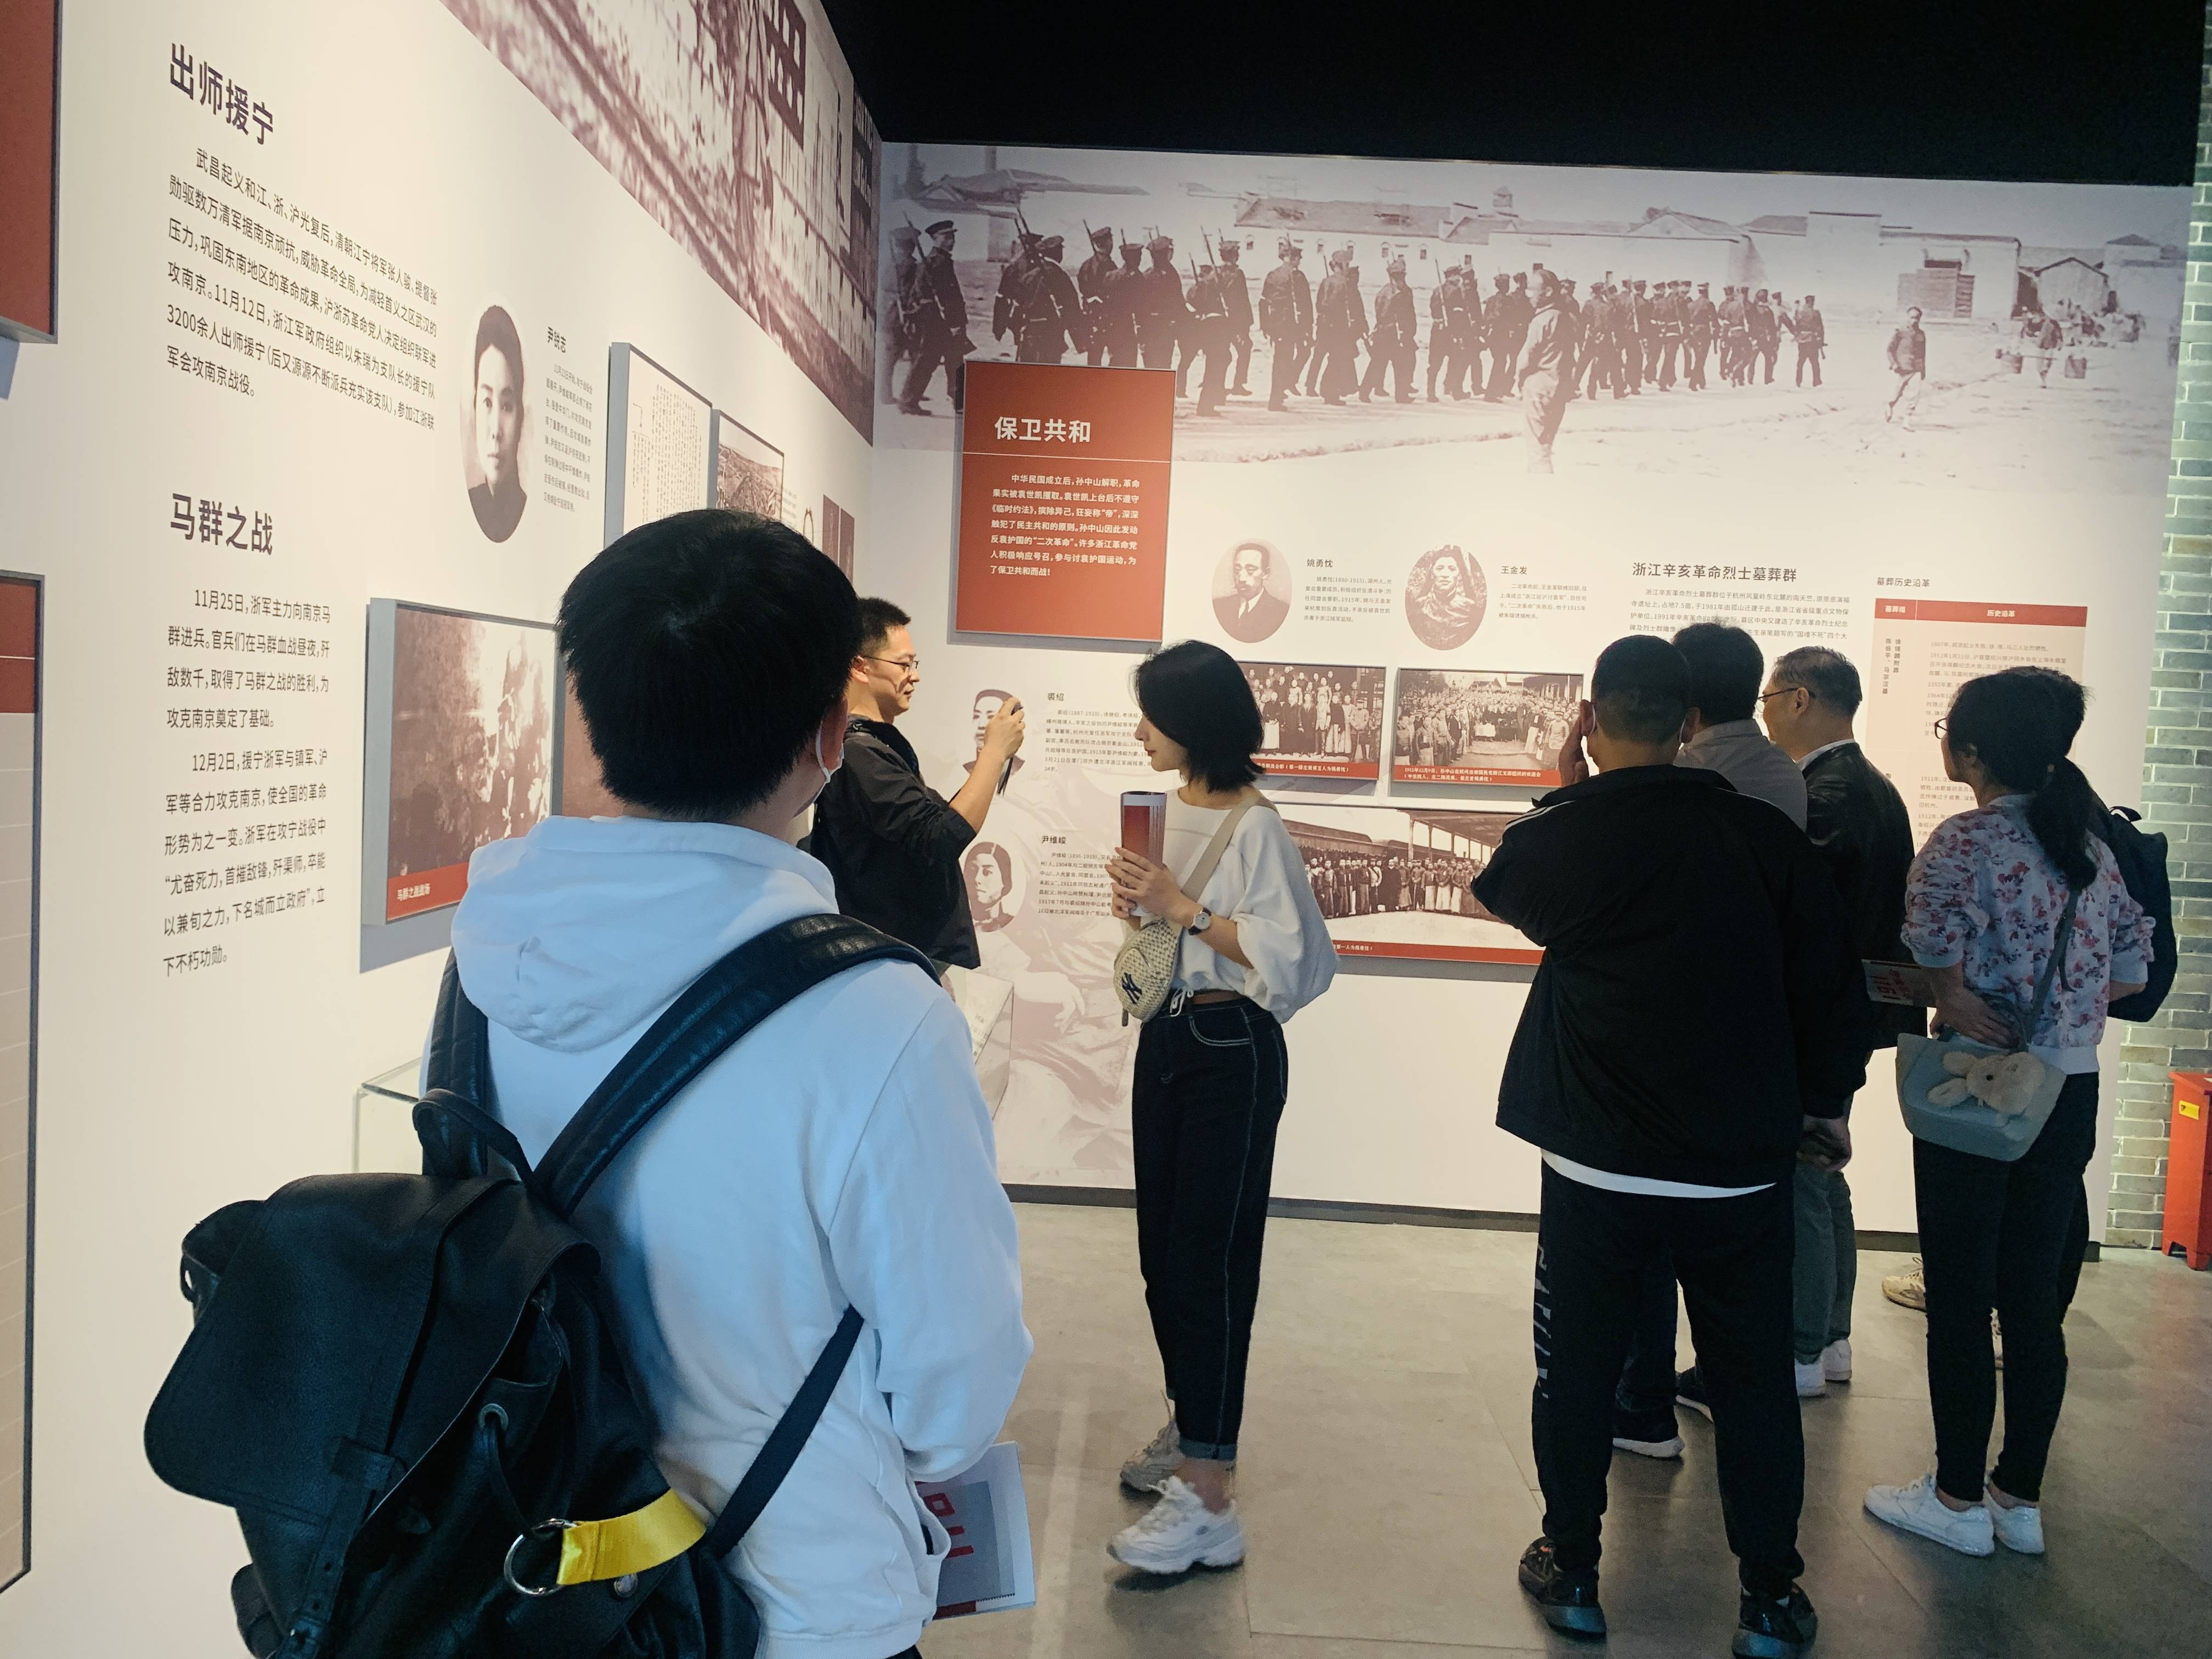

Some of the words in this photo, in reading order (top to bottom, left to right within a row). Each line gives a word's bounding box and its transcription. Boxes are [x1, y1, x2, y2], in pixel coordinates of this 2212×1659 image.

[170, 43, 273, 145] 出师援宁
[167, 346, 255, 397] 军会攻南京战役。
[994, 416, 1091, 443] 保卫共和
[1011, 474, 1141, 489] 中华民国成立后，孙中山解职，革命
[171, 493, 273, 555] 马群之战
[990, 565, 1051, 577] 了保卫共和而战！
[1306, 558, 1333, 568] 姚勇忱
[1501, 566, 1527, 575] 王金发
[1632, 562, 1797, 582] 浙江辛亥革命烈士墓葬群
[1876, 577, 1931, 588] 墓葬历史沿革
[195, 589, 330, 624] 11月25日，浙军主力向南京马
[1987, 609, 2016, 618] 历史沿革
[167, 626, 330, 658] 群进兵。官兵们在马群血战昼夜，歼
[167, 667, 329, 693] 敌数千，取得了马群之战的胜利，为
[167, 708, 274, 729] 攻克南京奠定了基础。
[192, 748, 328, 772] 12月2日，援宁浙军与镇军、沪
[166, 782, 327, 815] 军等合力攻克南京，使全国的革命
[165, 817, 326, 856] 形势为之一变。浙军在攻宁战役中
[163, 944, 227, 977] 下不朽功勋。
